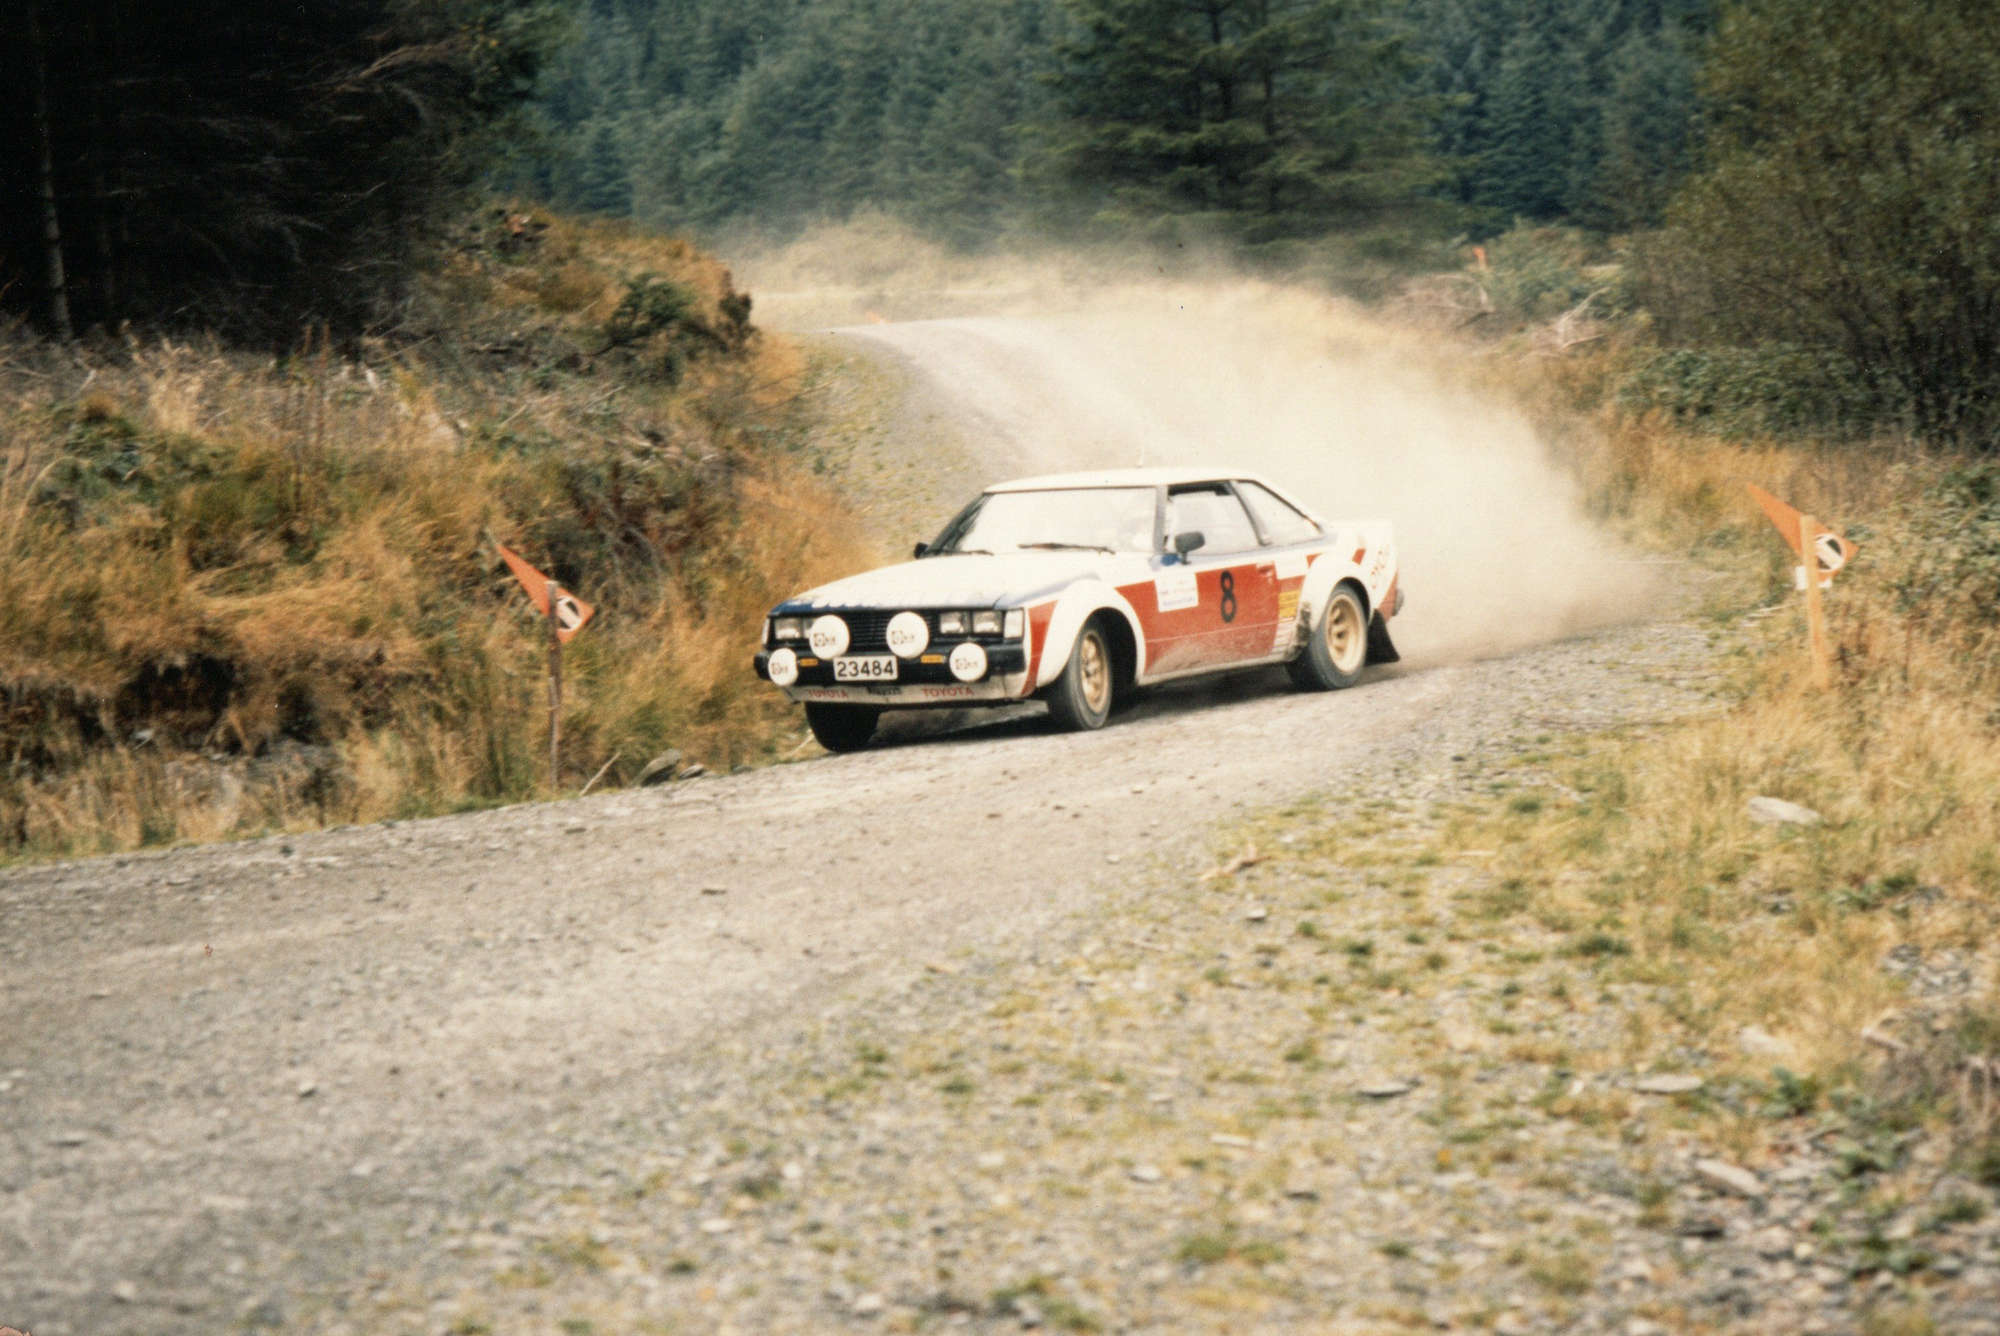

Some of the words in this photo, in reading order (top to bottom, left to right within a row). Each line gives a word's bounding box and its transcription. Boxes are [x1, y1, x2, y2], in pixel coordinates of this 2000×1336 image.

[1220, 570, 1237, 623] 8
[836, 660, 895, 678] 23484
[923, 687, 974, 697] TOYOTA
